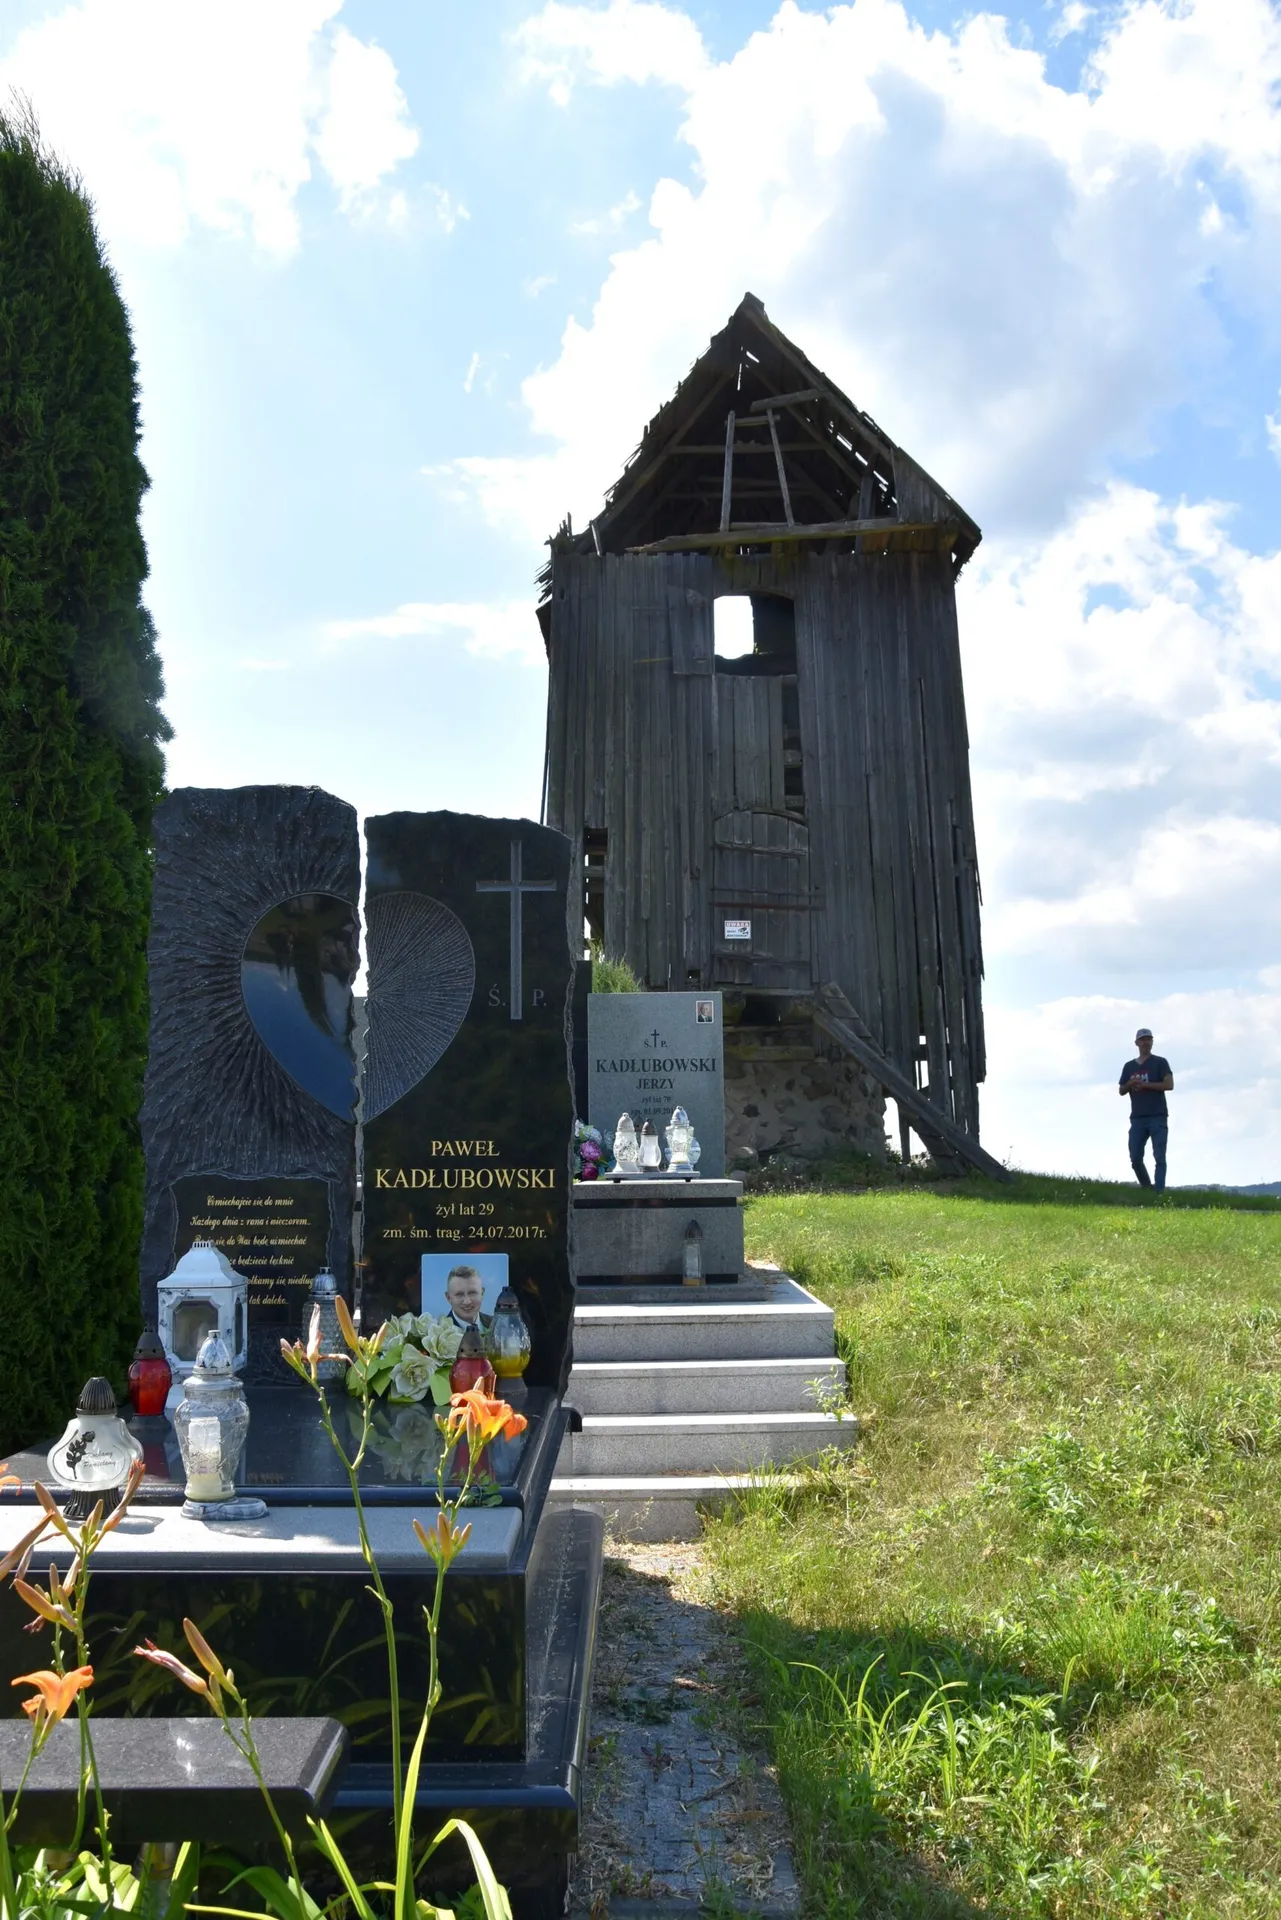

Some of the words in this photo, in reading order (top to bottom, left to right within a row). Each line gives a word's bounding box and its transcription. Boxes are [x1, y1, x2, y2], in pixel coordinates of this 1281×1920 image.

[488, 983, 506, 1007] Ś.
[532, 989, 547, 1007] P.
[596, 1058, 717, 1073] KADŁUBOWSKI
[636, 1078, 675, 1090] JERZY
[431, 1140, 500, 1157] PAWEŁ
[374, 1168, 556, 1189] KADŁUBOWSKI
[264, 1195, 274, 1206] do
[275, 1196, 294, 1206] mnie
[435, 1203, 455, 1218] żył
[459, 1203, 475, 1216] lat
[478, 1203, 495, 1216] 29
[222, 1215, 240, 1226] dnia
[383, 1229, 406, 1239] zm.
[410, 1226, 432, 1239] śm.
[436, 1228, 464, 1241] trag.
[468, 1226, 548, 1239] 24.07.2017r.
[247, 1274, 274, 1289] otkamy
[288, 1274, 313, 1289] niedług
